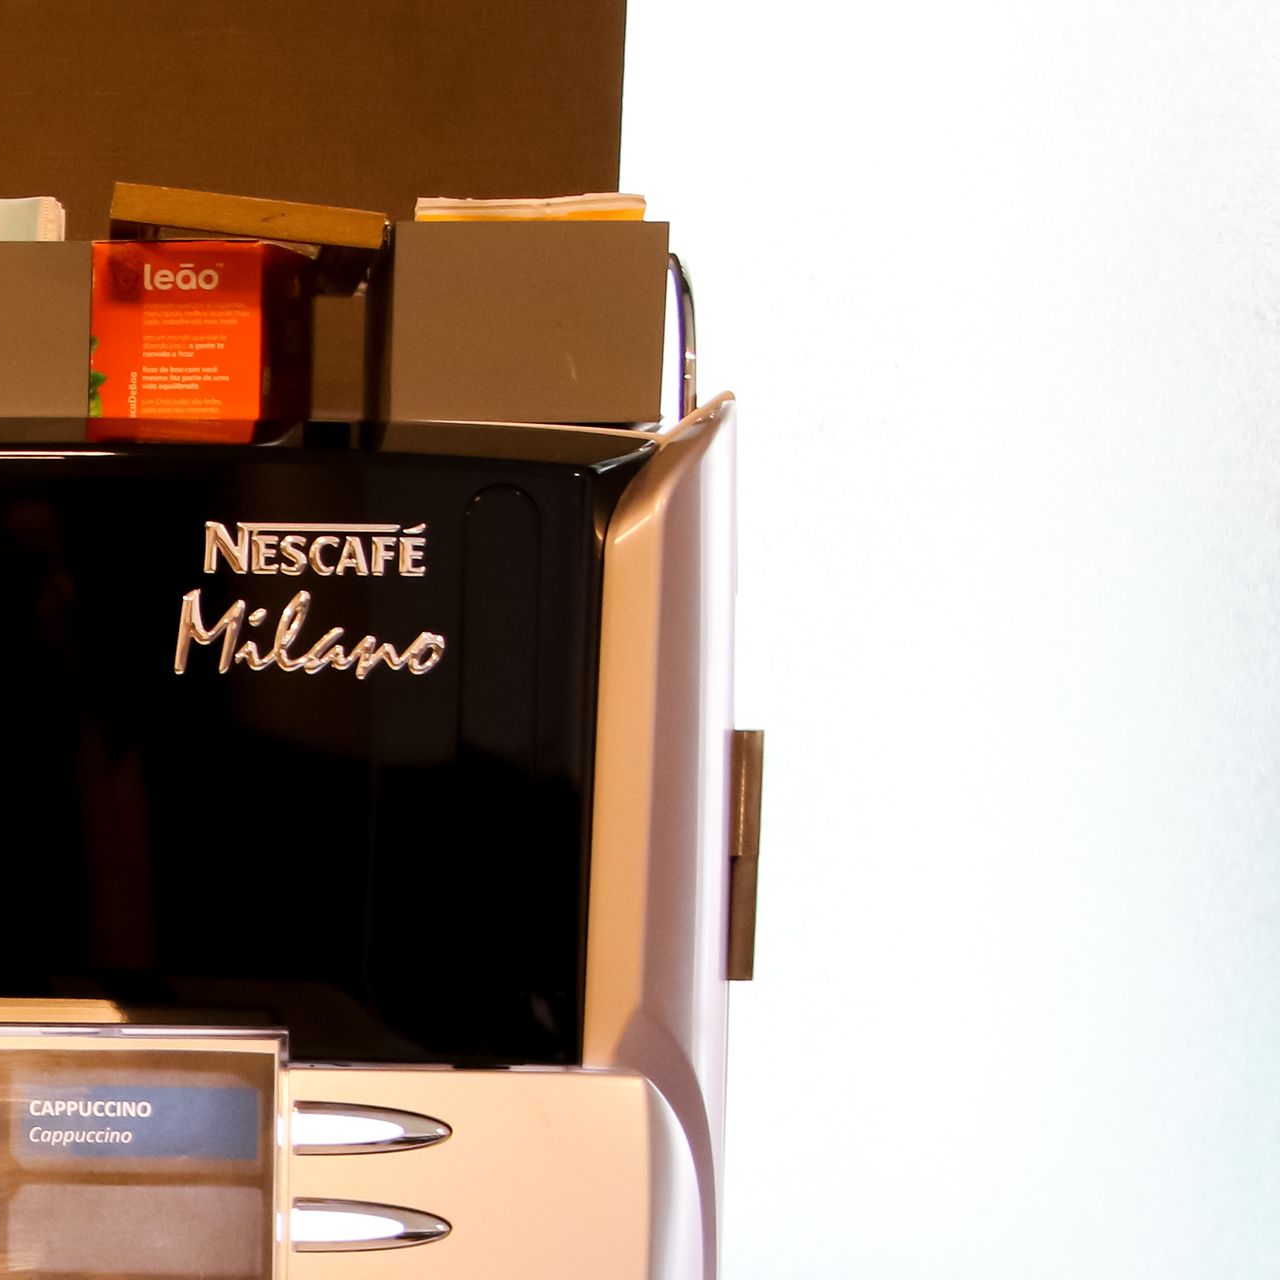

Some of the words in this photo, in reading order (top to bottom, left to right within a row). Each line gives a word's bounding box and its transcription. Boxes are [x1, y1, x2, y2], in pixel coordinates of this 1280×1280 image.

[144, 264, 219, 290] leão
[204, 521, 426, 576] NESCAFÉ
[174, 588, 446, 679] Milano
[29, 1099, 151, 1118] CAPPUCCINO
[28, 1126, 132, 1146] Cappuccino
